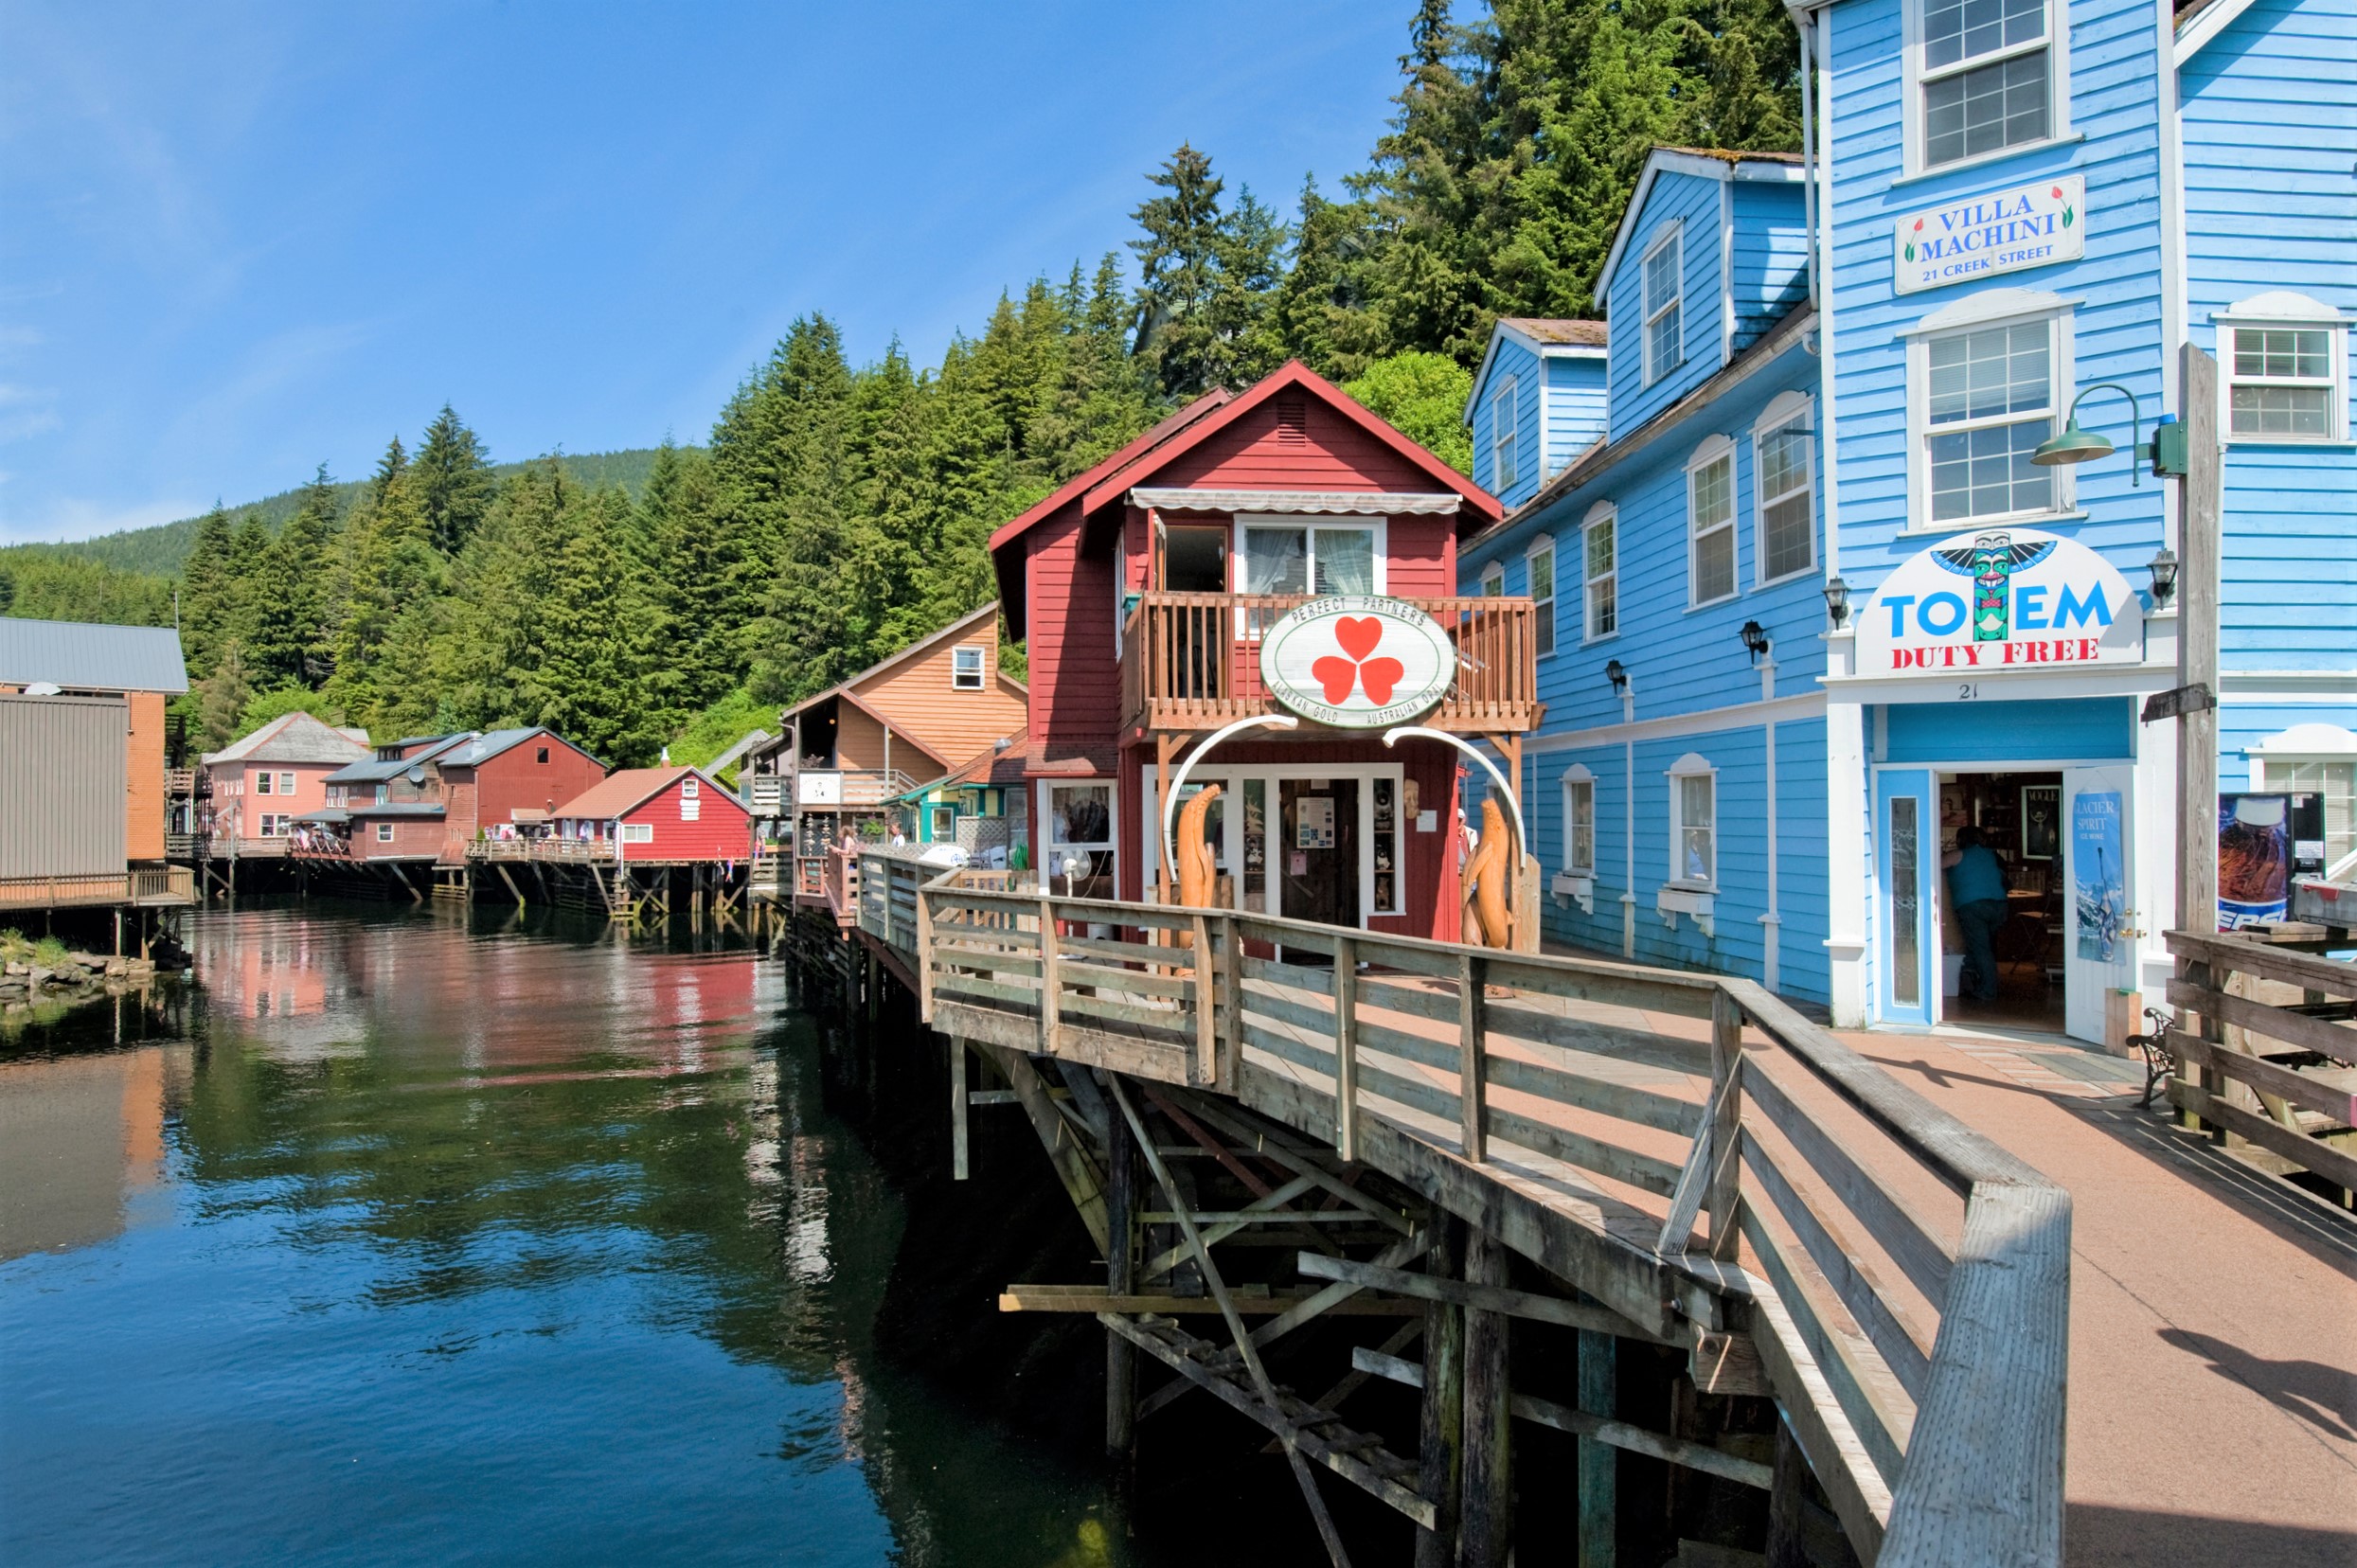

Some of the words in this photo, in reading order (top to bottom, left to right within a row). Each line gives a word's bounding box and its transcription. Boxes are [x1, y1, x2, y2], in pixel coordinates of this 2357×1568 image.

[1938, 194, 2034, 231] VILLA
[1920, 213, 2056, 262] MACHINI
[1922, 272, 1937, 281] 21
[1944, 257, 1990, 276] CREEK
[1999, 244, 2053, 265] STREET
[1292, 597, 1346, 624] PERFECT
[1364, 597, 1426, 626] PARTNERS
[1891, 645, 1984, 668] DUTY
[2002, 638, 2098, 664] FREE
[1272, 680, 1310, 712] ALASKAN
[1313, 706, 1338, 723] GOLD
[1366, 701, 1419, 724] AUSTRALIAN
[1421, 683, 1444, 704] OPAL
[1959, 684, 1977, 700] 21
[2028, 790, 2058, 801] VOGUE
[2078, 817, 2107, 830] SPIRIT
[2218, 909, 2287, 931] EPSI
